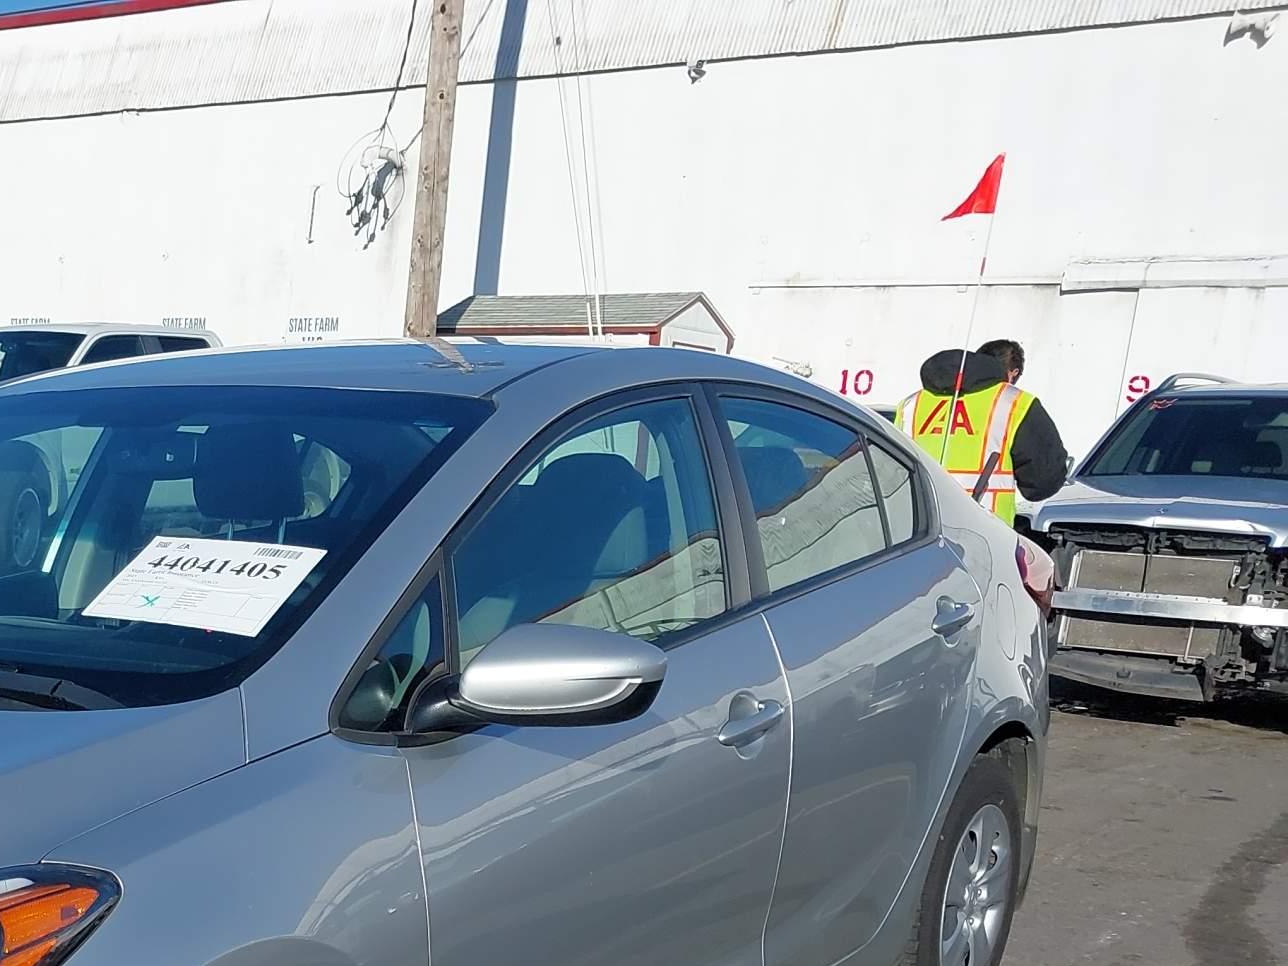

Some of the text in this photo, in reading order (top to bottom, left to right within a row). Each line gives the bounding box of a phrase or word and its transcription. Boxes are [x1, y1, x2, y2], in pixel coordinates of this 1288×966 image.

[184, 317, 207, 330] FARM
[288, 317, 339, 332] STATE FARM
[839, 369, 874, 396] 10
[1126, 375, 1150, 402] 9
[147, 554, 288, 580] 44041405
